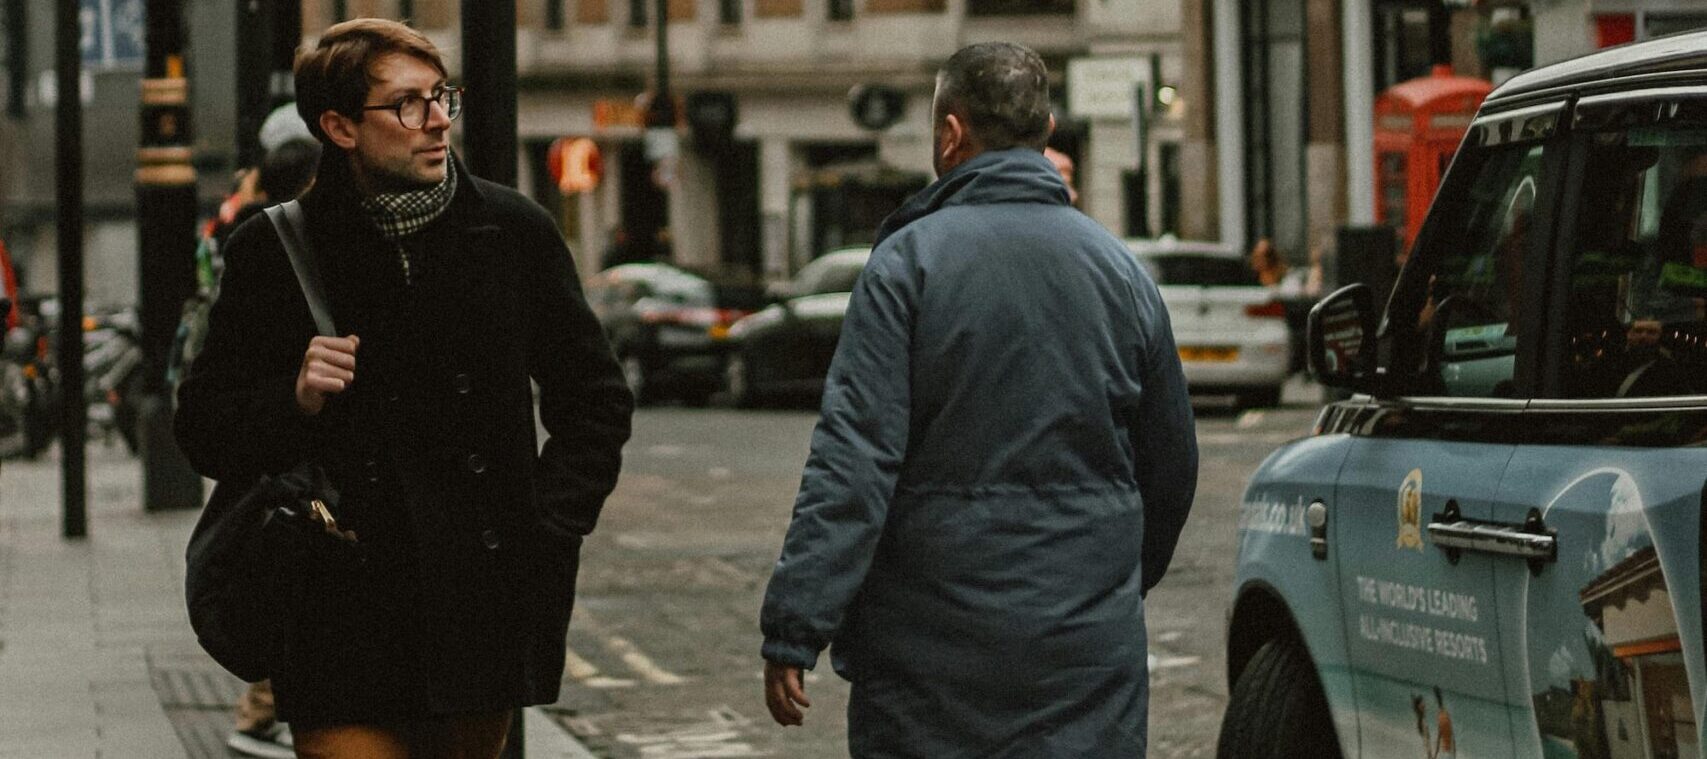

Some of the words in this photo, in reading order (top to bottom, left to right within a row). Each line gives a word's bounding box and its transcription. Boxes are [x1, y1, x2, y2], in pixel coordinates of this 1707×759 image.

[1357, 576, 1377, 604] THE
[1379, 581, 1426, 612] WORLD'S
[1428, 588, 1478, 622] LEADING
[1360, 613, 1434, 653] ALL-INCLUSIVE
[1435, 629, 1488, 663] RESORTS
